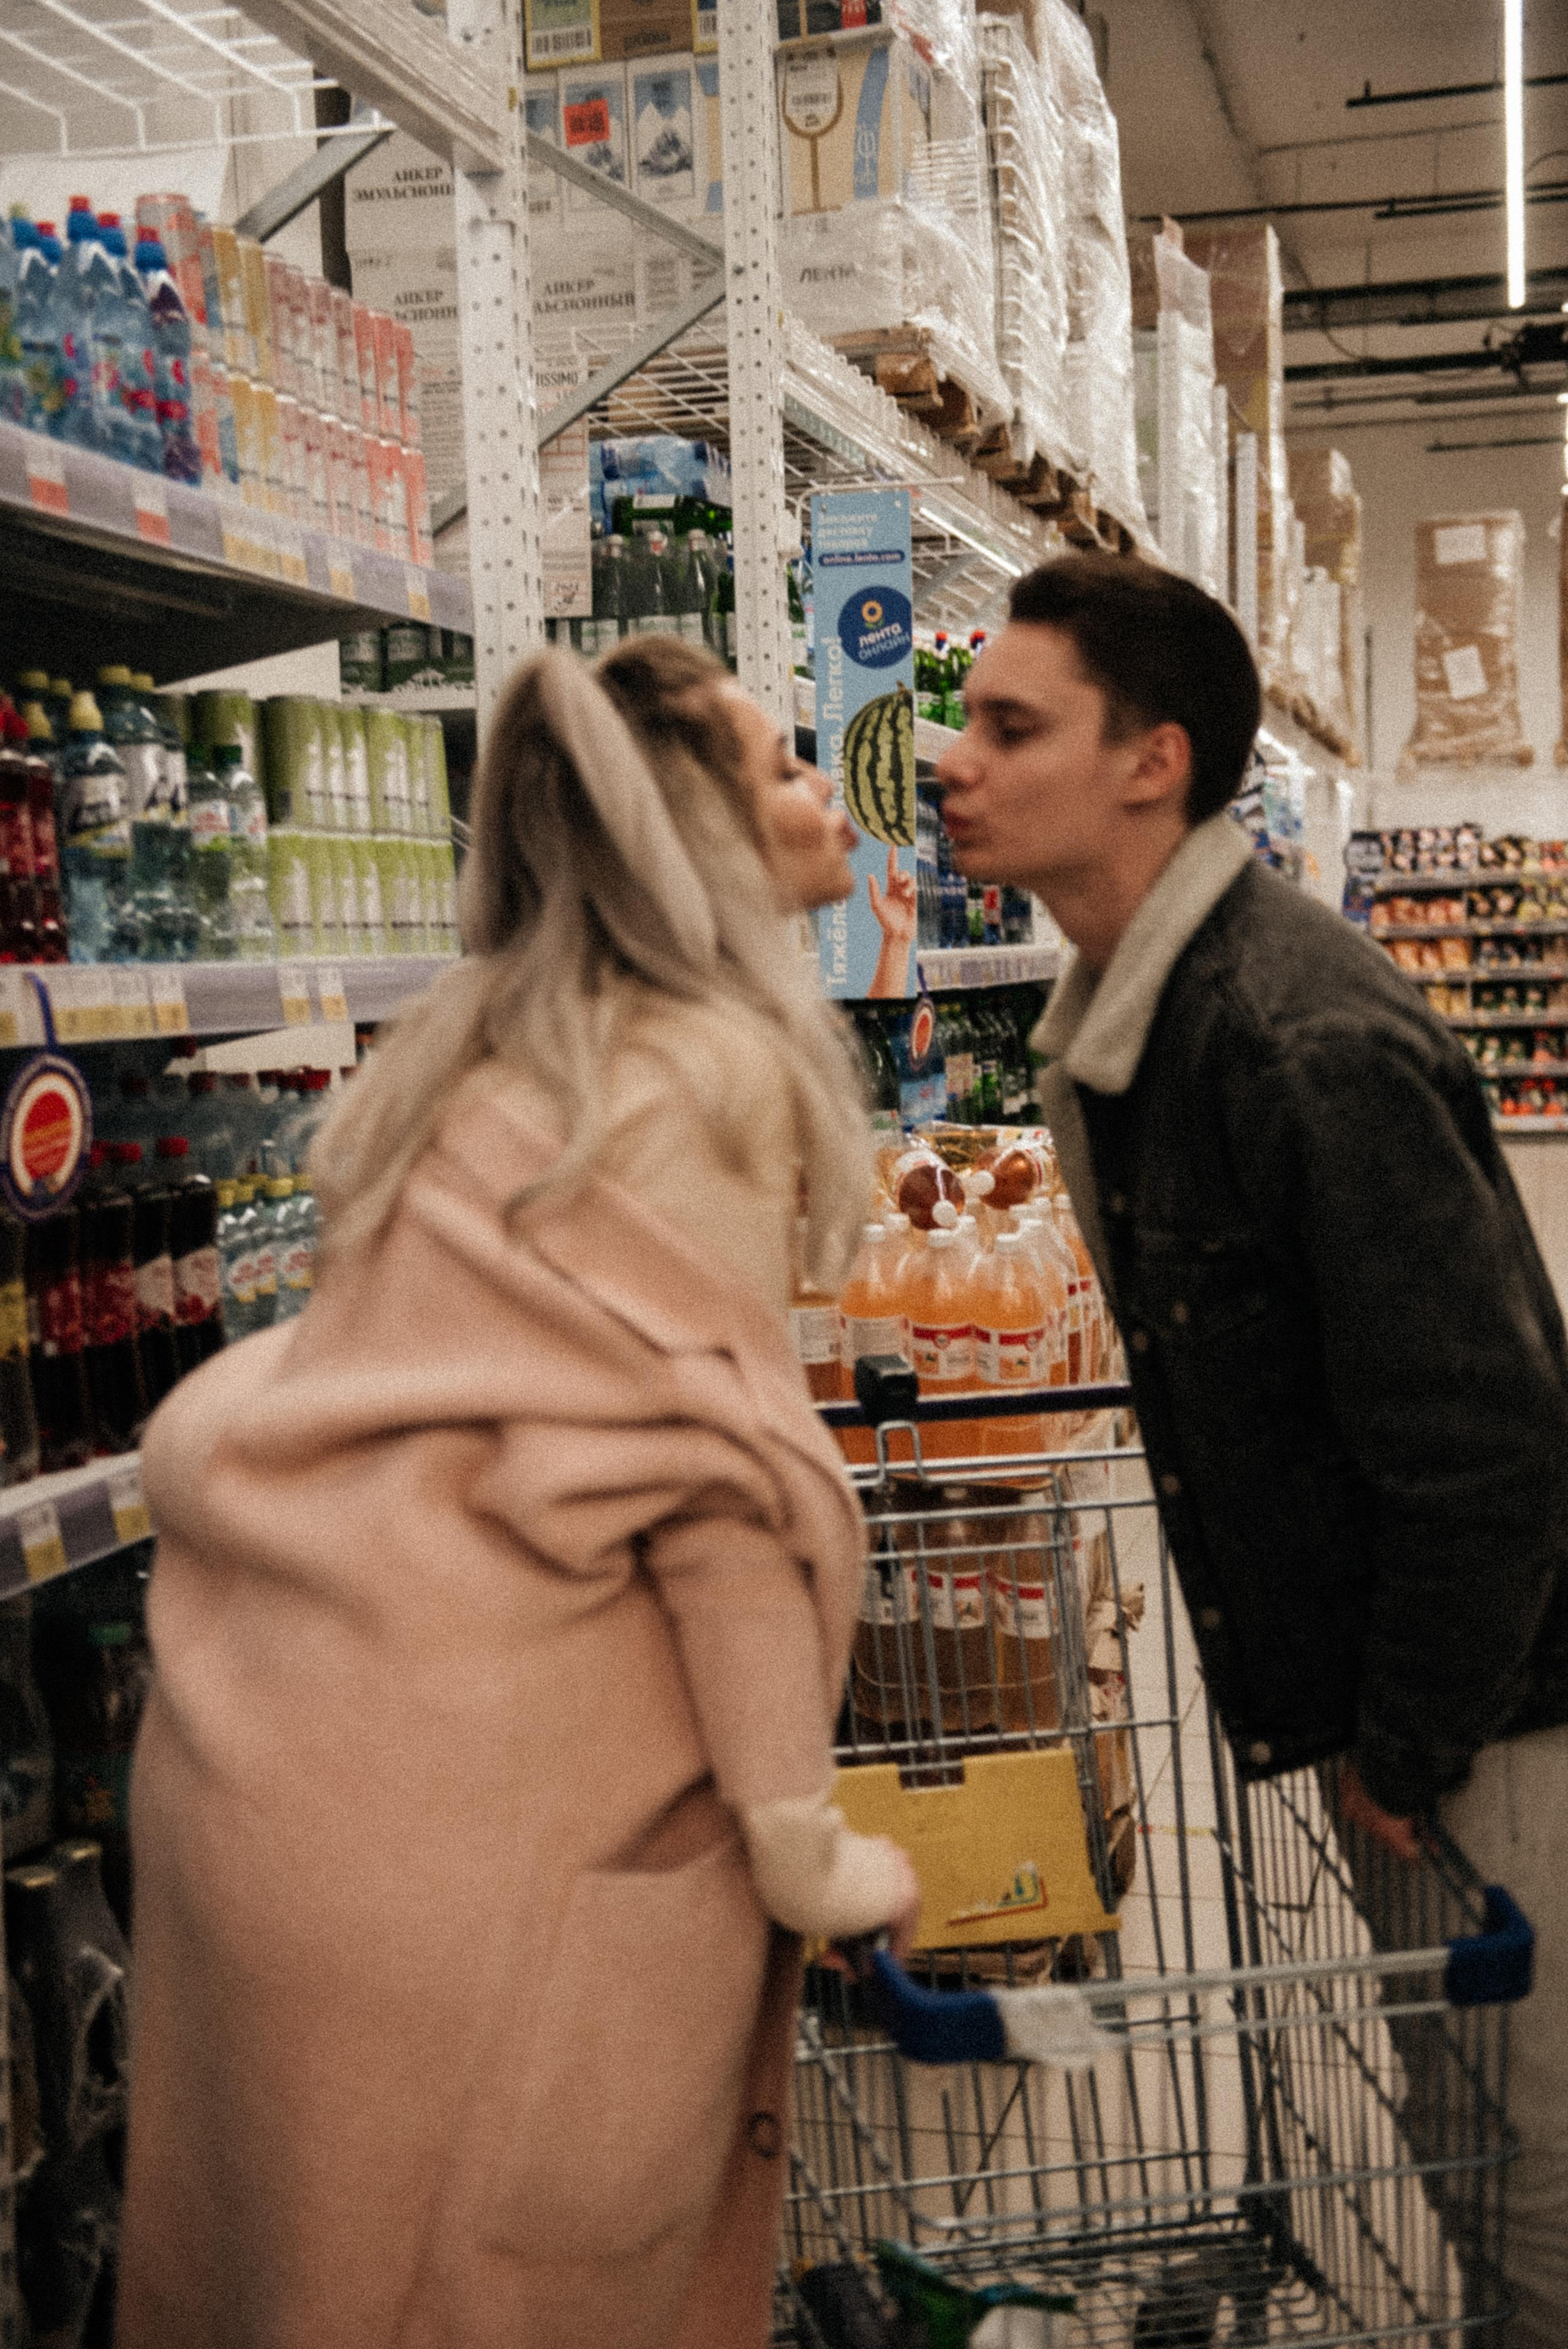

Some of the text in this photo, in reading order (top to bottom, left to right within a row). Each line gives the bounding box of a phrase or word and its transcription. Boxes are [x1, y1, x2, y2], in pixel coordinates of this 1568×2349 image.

[393, 167, 443, 182] АНКЕР
[543, 279, 595, 295] АНКЕР
[394, 289, 443, 305] АНКЕР
[532, 291, 635, 314] ЛЬСИОННЫЙ
[858, 622, 903, 648] лента
[820, 637, 844, 722] Легко!
